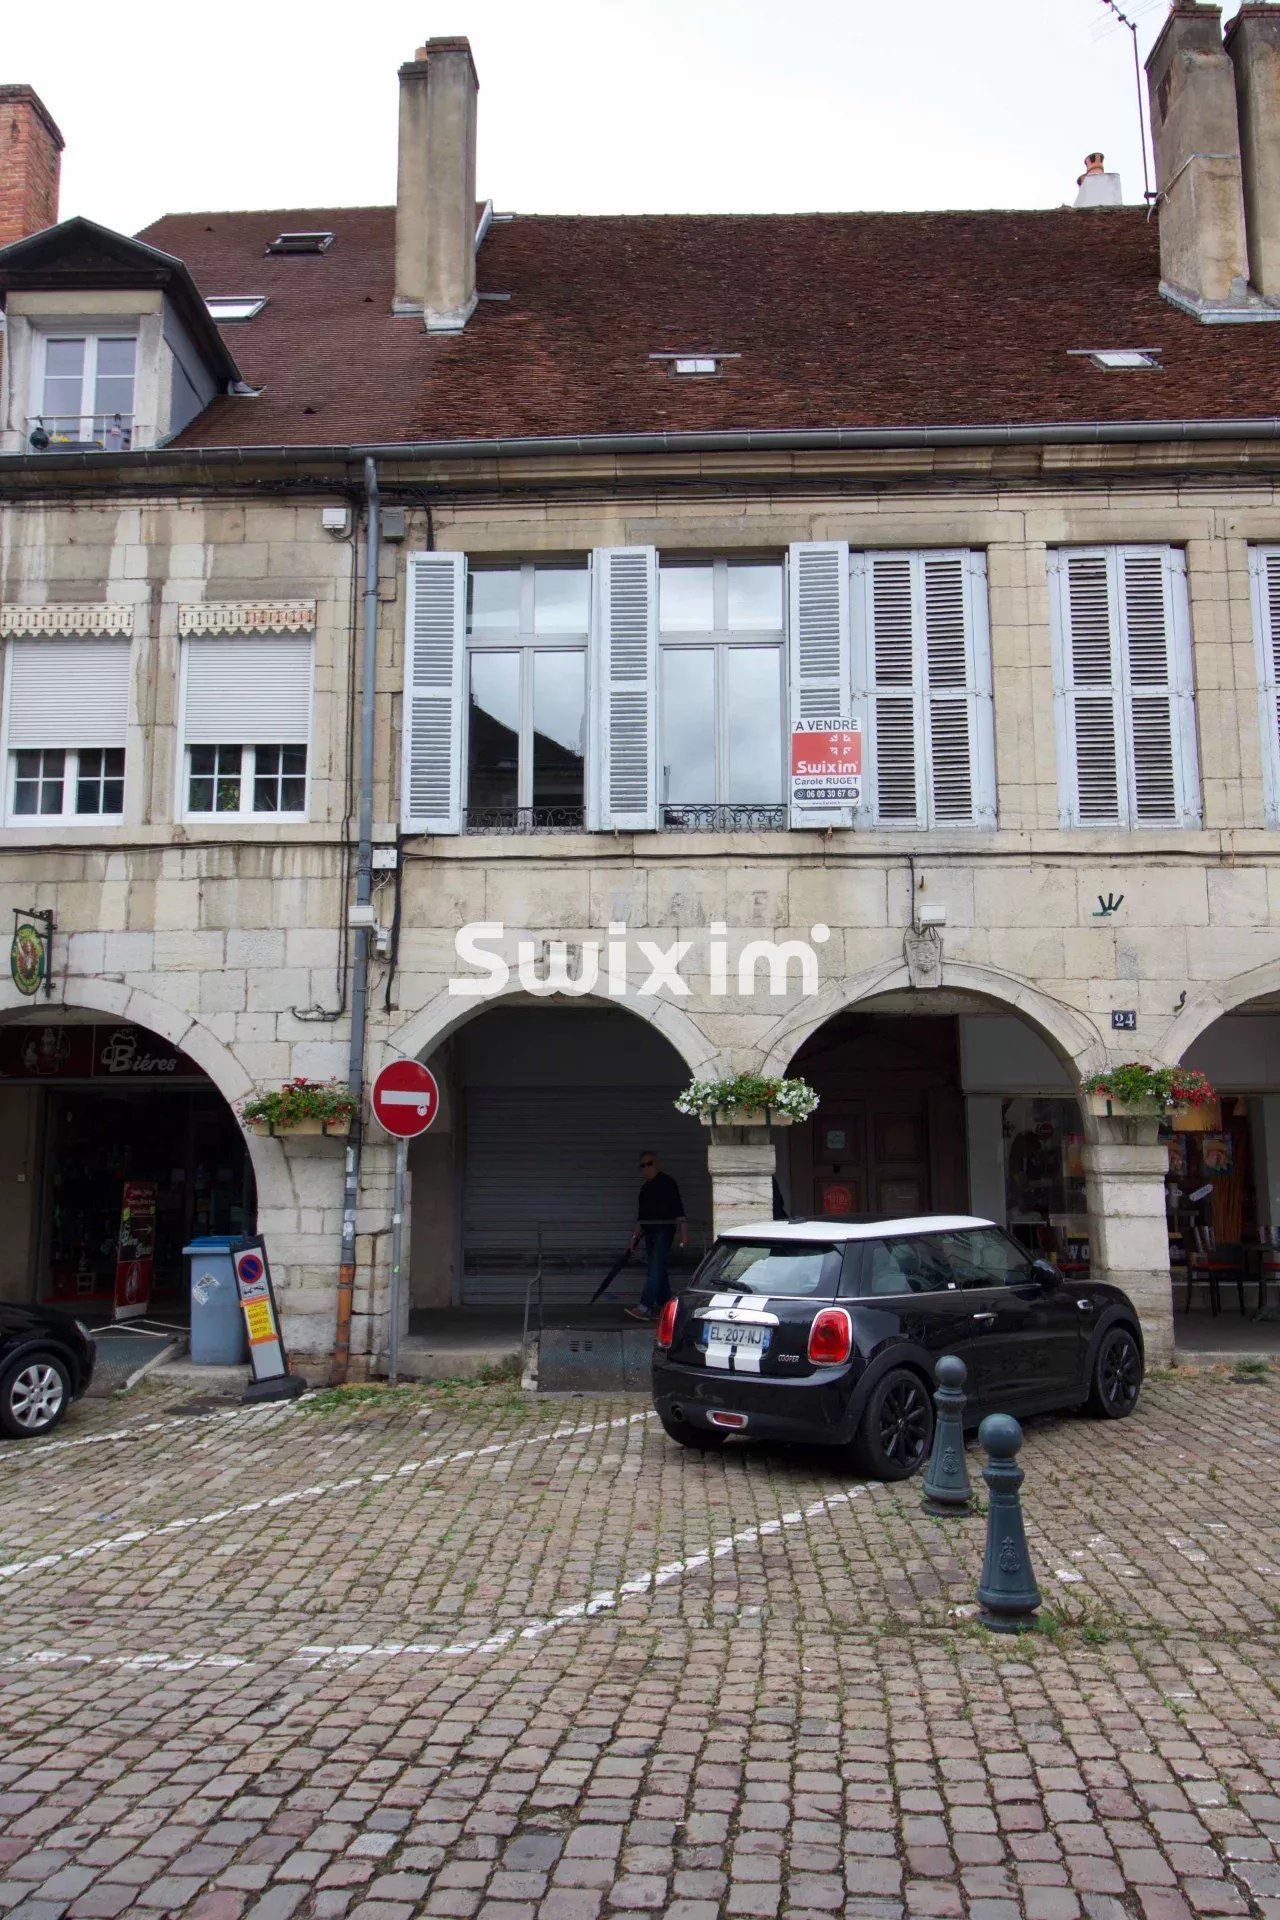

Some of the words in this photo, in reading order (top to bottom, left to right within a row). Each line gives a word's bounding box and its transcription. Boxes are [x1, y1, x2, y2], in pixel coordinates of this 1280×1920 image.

[795, 721, 805, 731] A
[807, 720, 858, 731] VENDRE
[796, 761, 857, 774] Swixim
[794, 777, 823, 786] Carole
[825, 777, 858, 785] RUGET
[806, 790, 815, 798] 06
[827, 790, 836, 798] 30
[837, 790, 846, 798] 67
[1115, 1013, 1134, 1027] 24
[778, 1354, 800, 1363] COOPER
